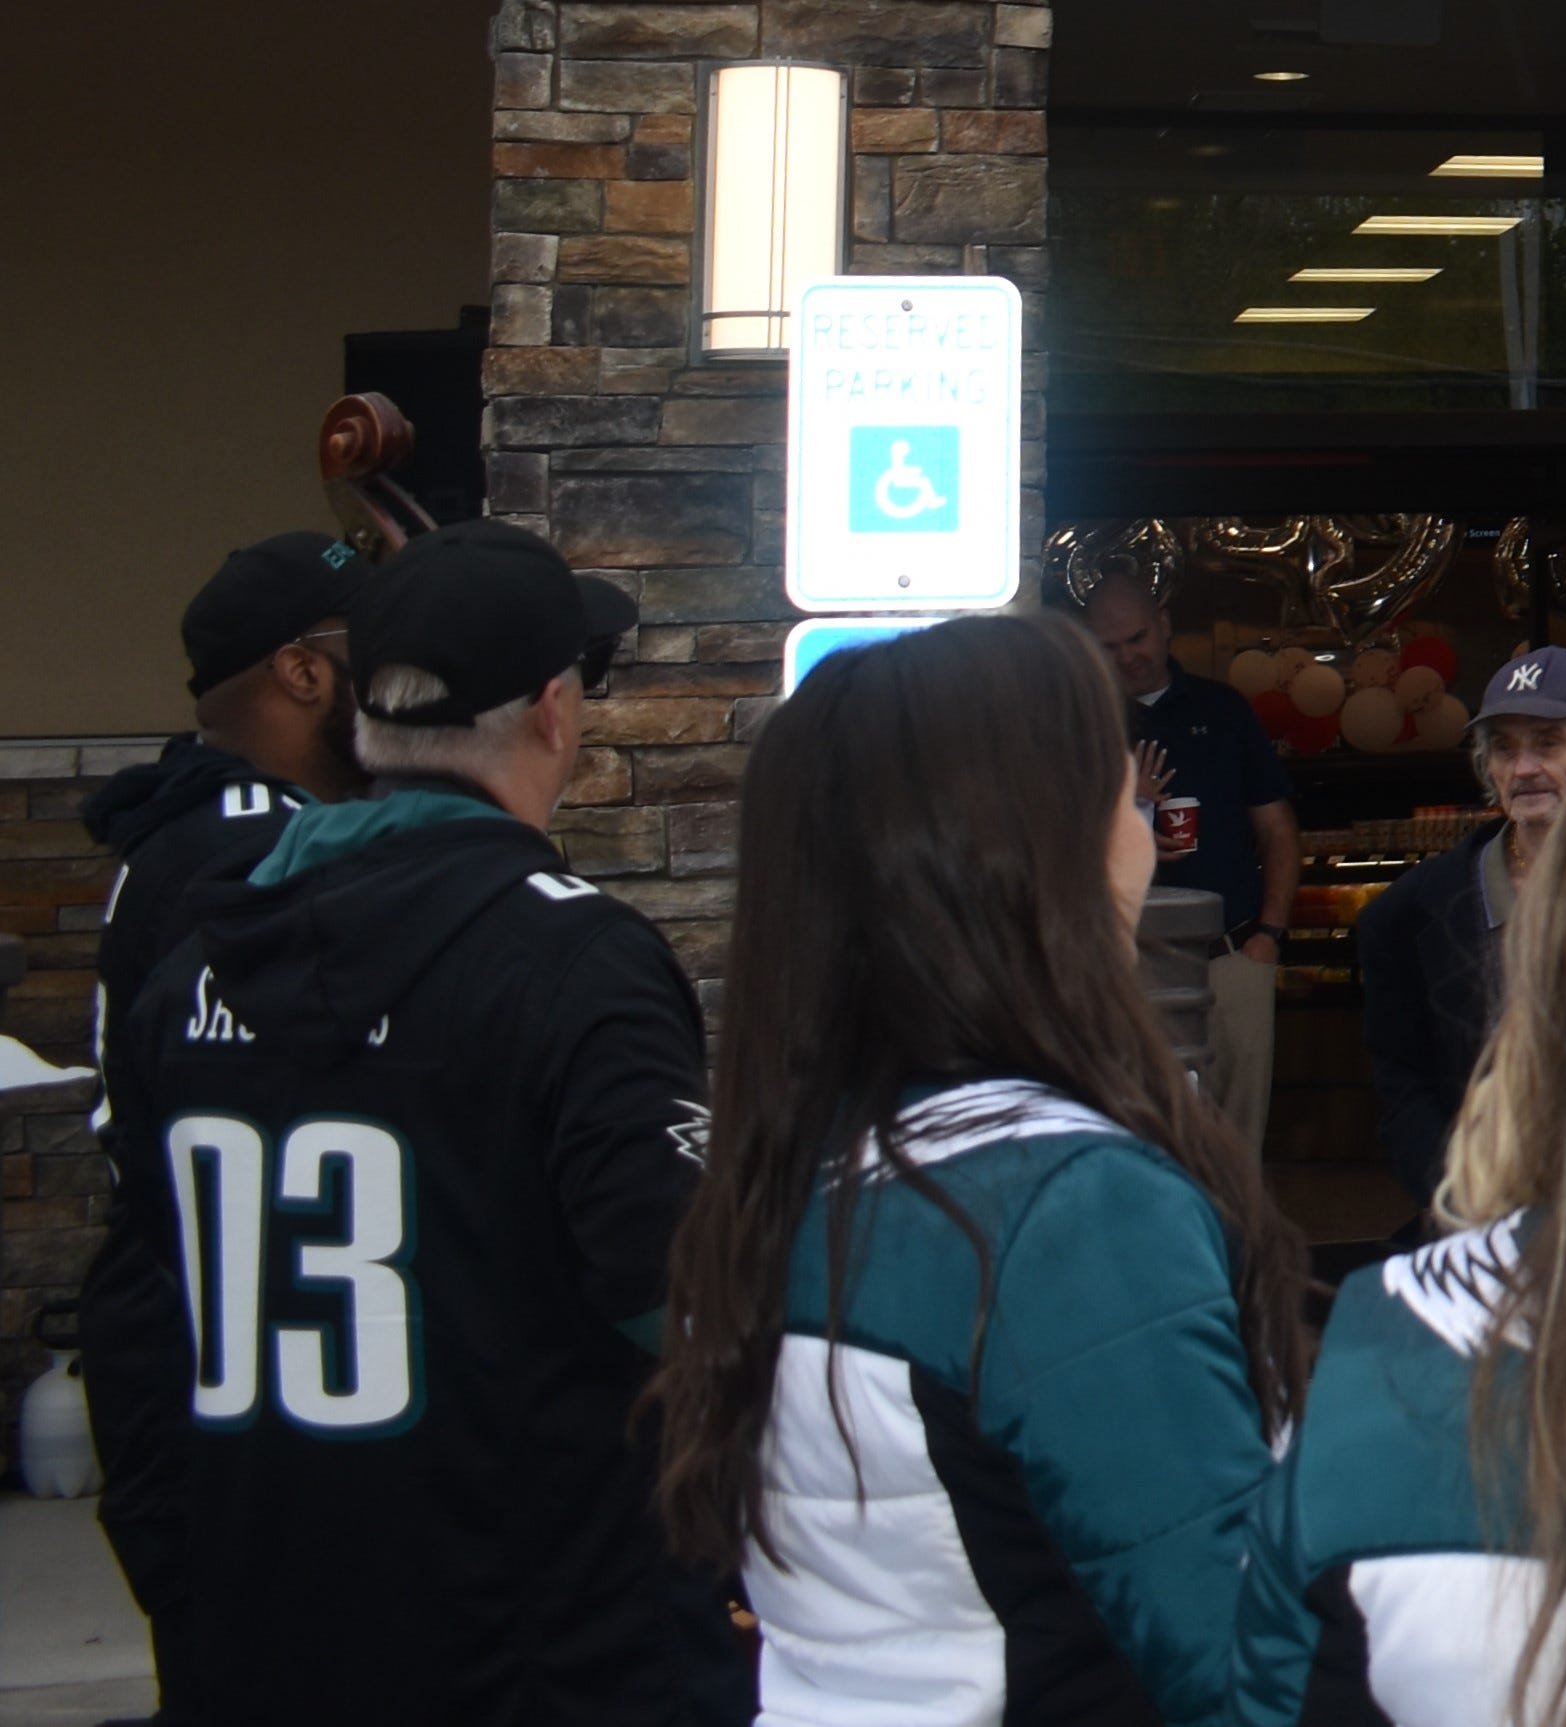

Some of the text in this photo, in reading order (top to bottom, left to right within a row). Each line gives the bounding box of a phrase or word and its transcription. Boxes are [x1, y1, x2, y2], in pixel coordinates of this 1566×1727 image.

[812, 313, 998, 353] RESERVED
[825, 368, 988, 406] PARKING
[1506, 663, 1543, 691] NY
